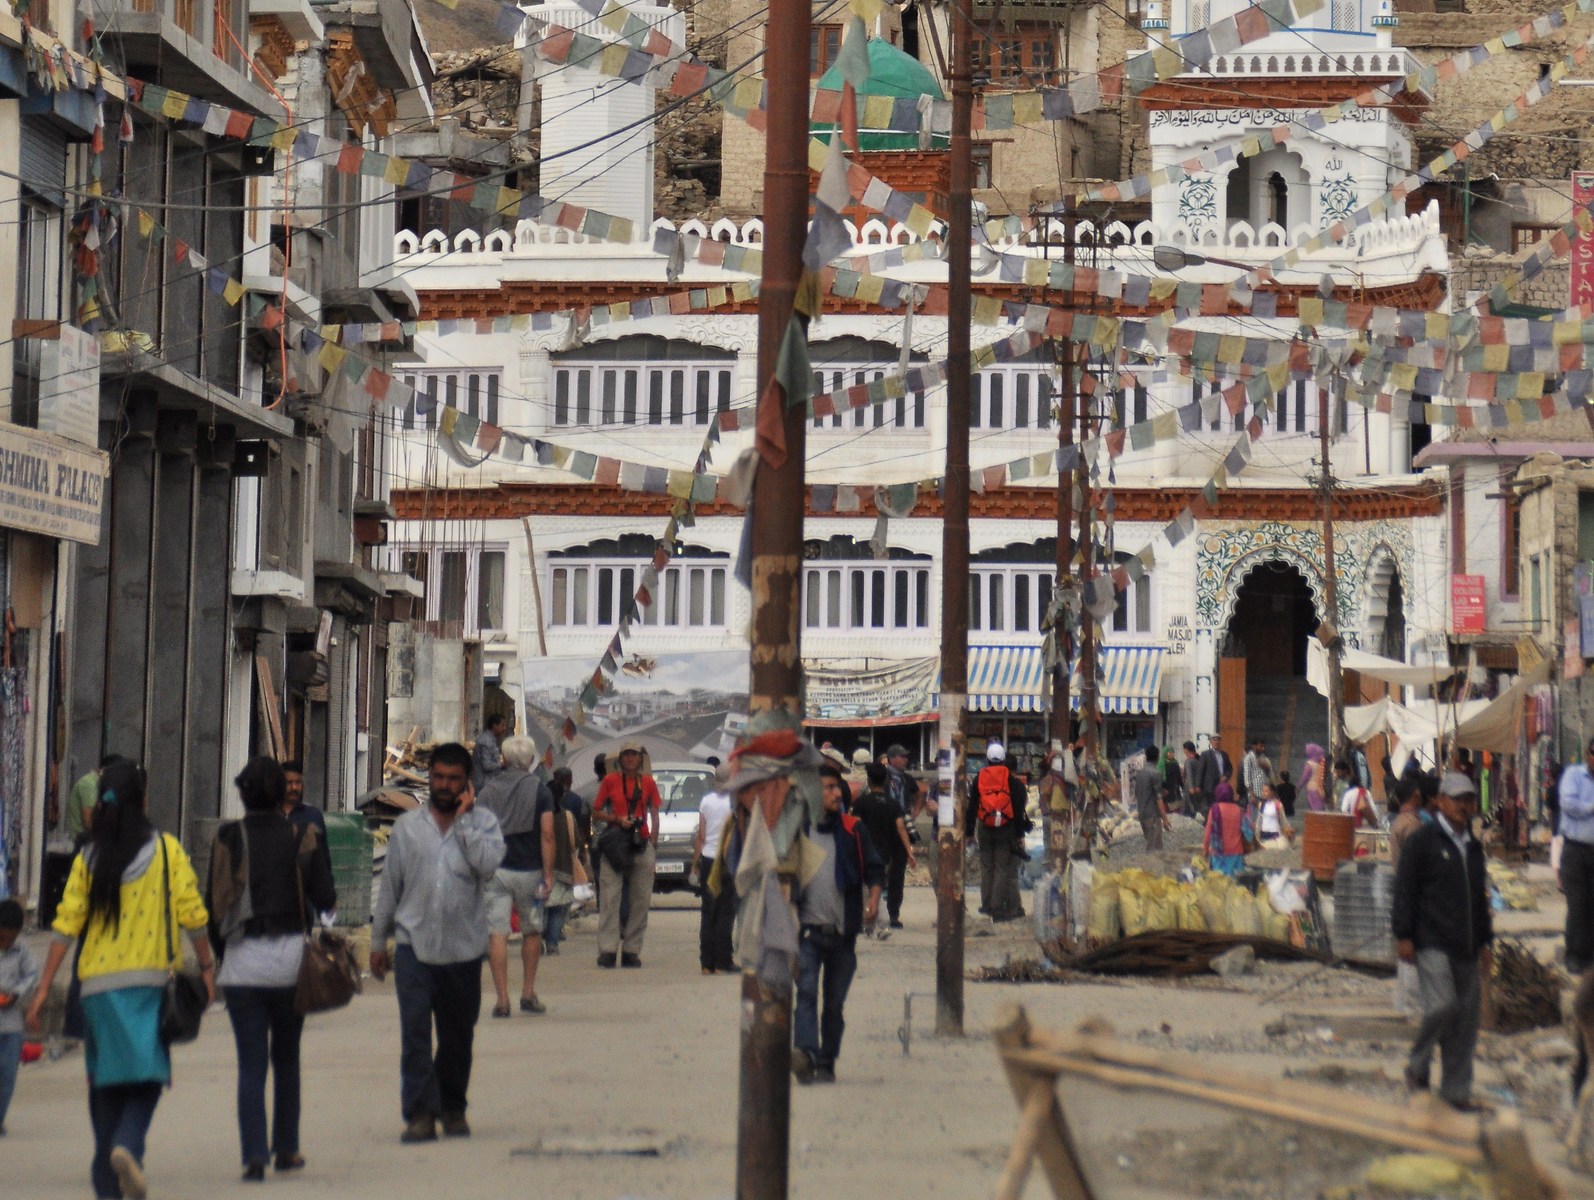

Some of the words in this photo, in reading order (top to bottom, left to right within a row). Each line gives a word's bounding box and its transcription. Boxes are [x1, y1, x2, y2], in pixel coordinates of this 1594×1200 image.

[55, 464, 102, 506] PALACE
[1169, 616, 1188, 627] JAMIA
[1168, 629, 1192, 641] MASJID
[1171, 642, 1185, 655] LEH
